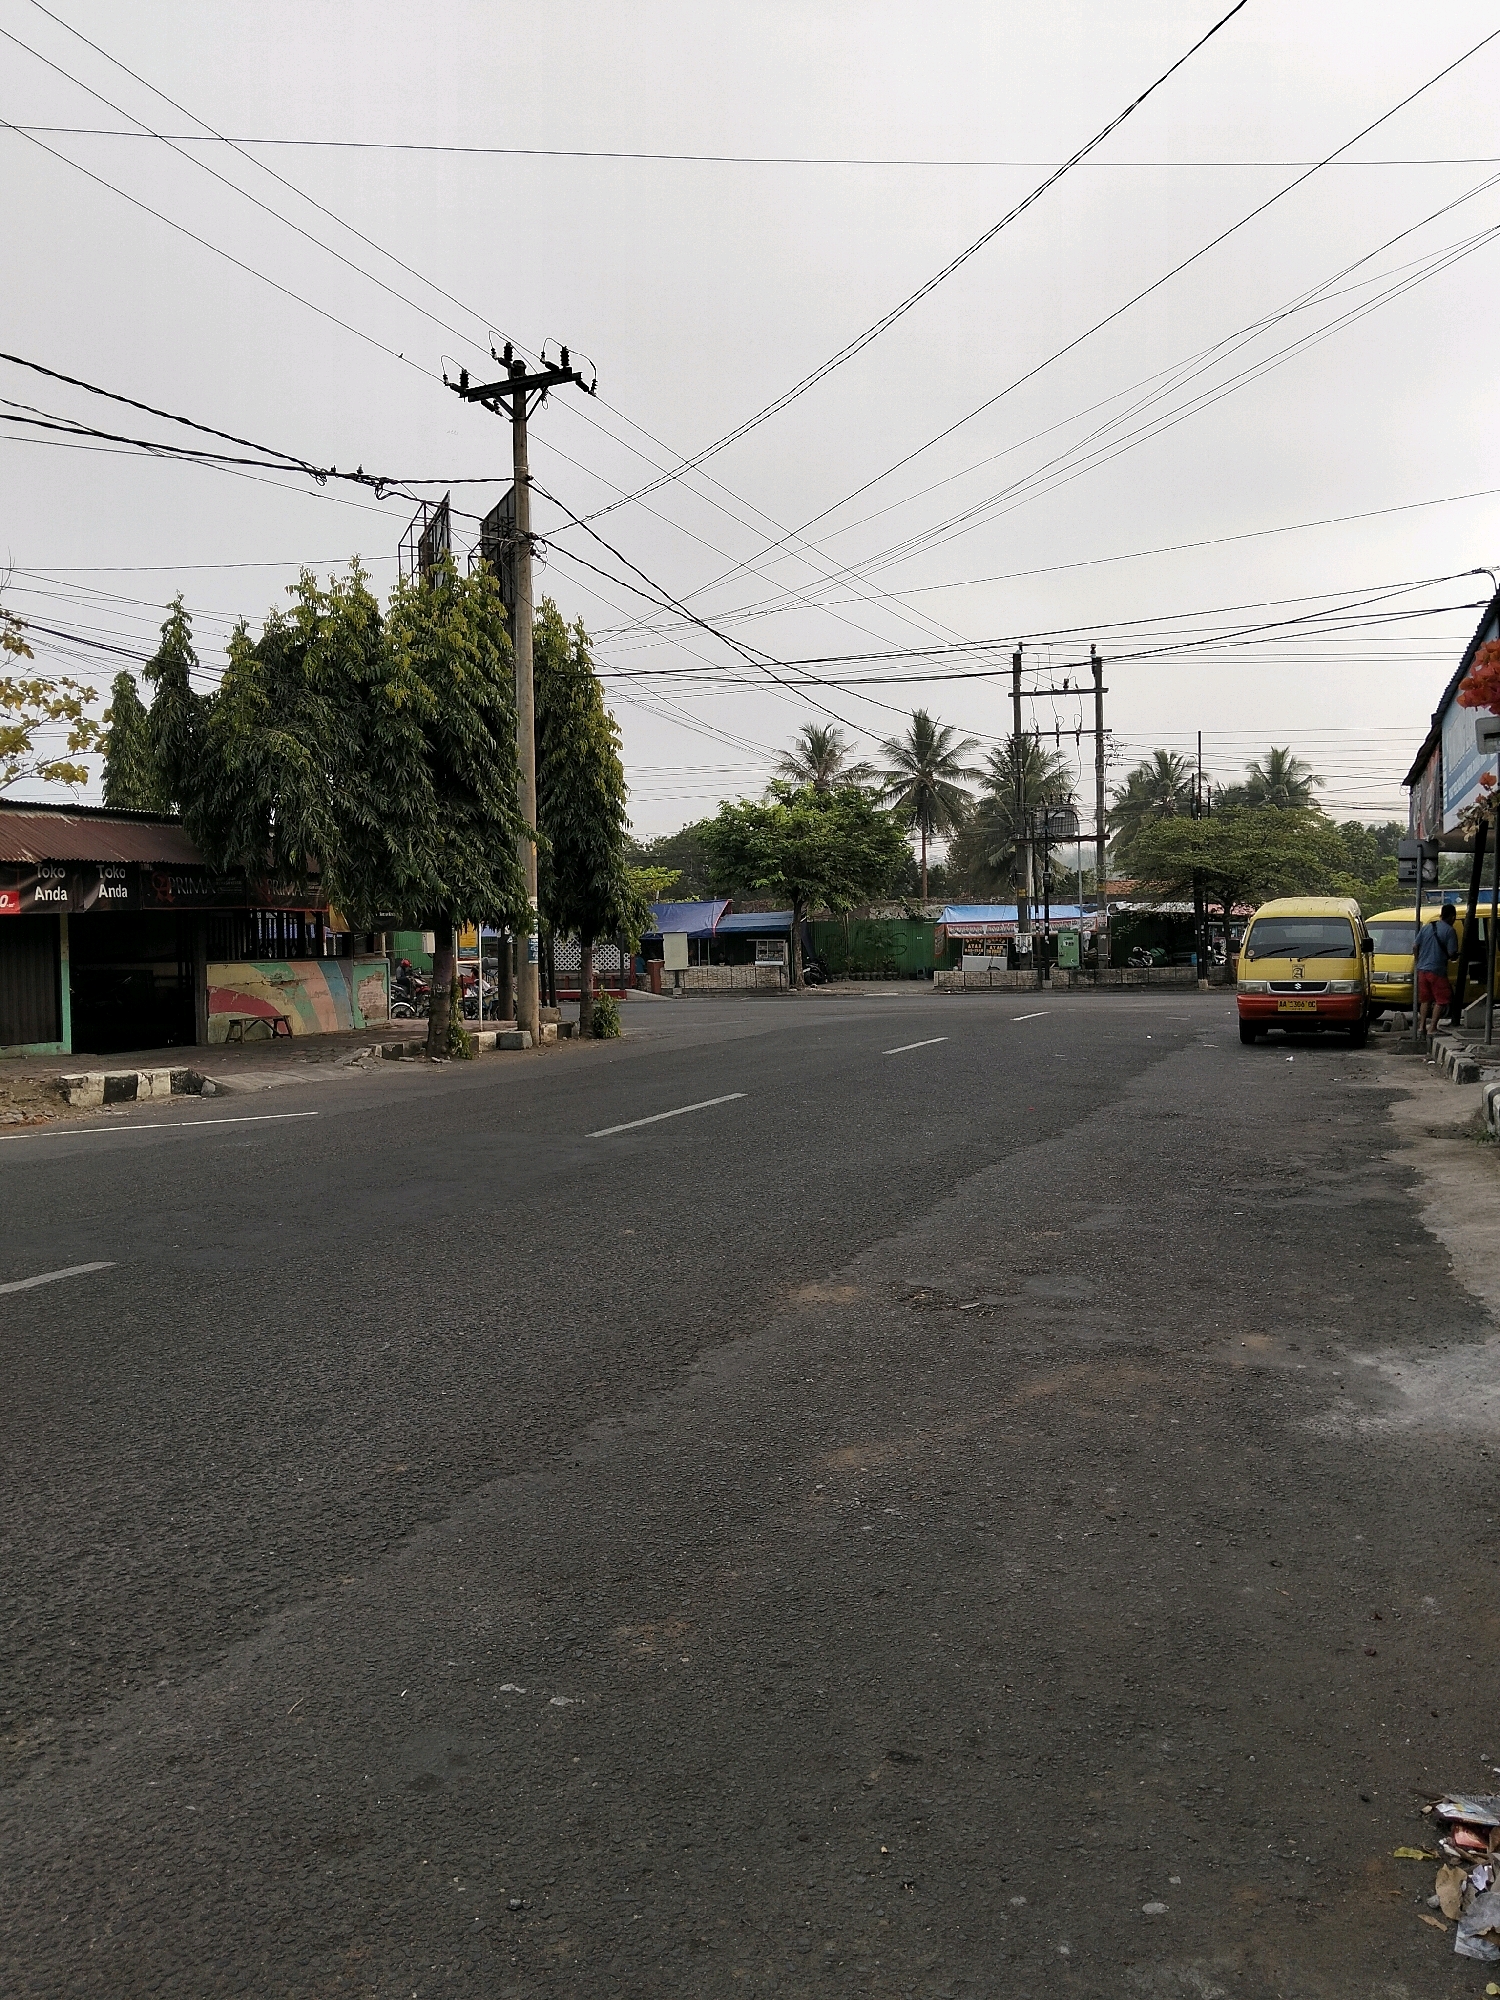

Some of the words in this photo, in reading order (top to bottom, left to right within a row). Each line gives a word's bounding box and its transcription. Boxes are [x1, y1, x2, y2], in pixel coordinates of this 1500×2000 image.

[35, 863, 66, 879] Toko
[96, 864, 126, 879] Toko
[98, 884, 128, 898] Anda
[169, 876, 217, 894] PRIMA
[267, 878, 304, 896] PRIMA
[34, 886, 68, 901] Anda
